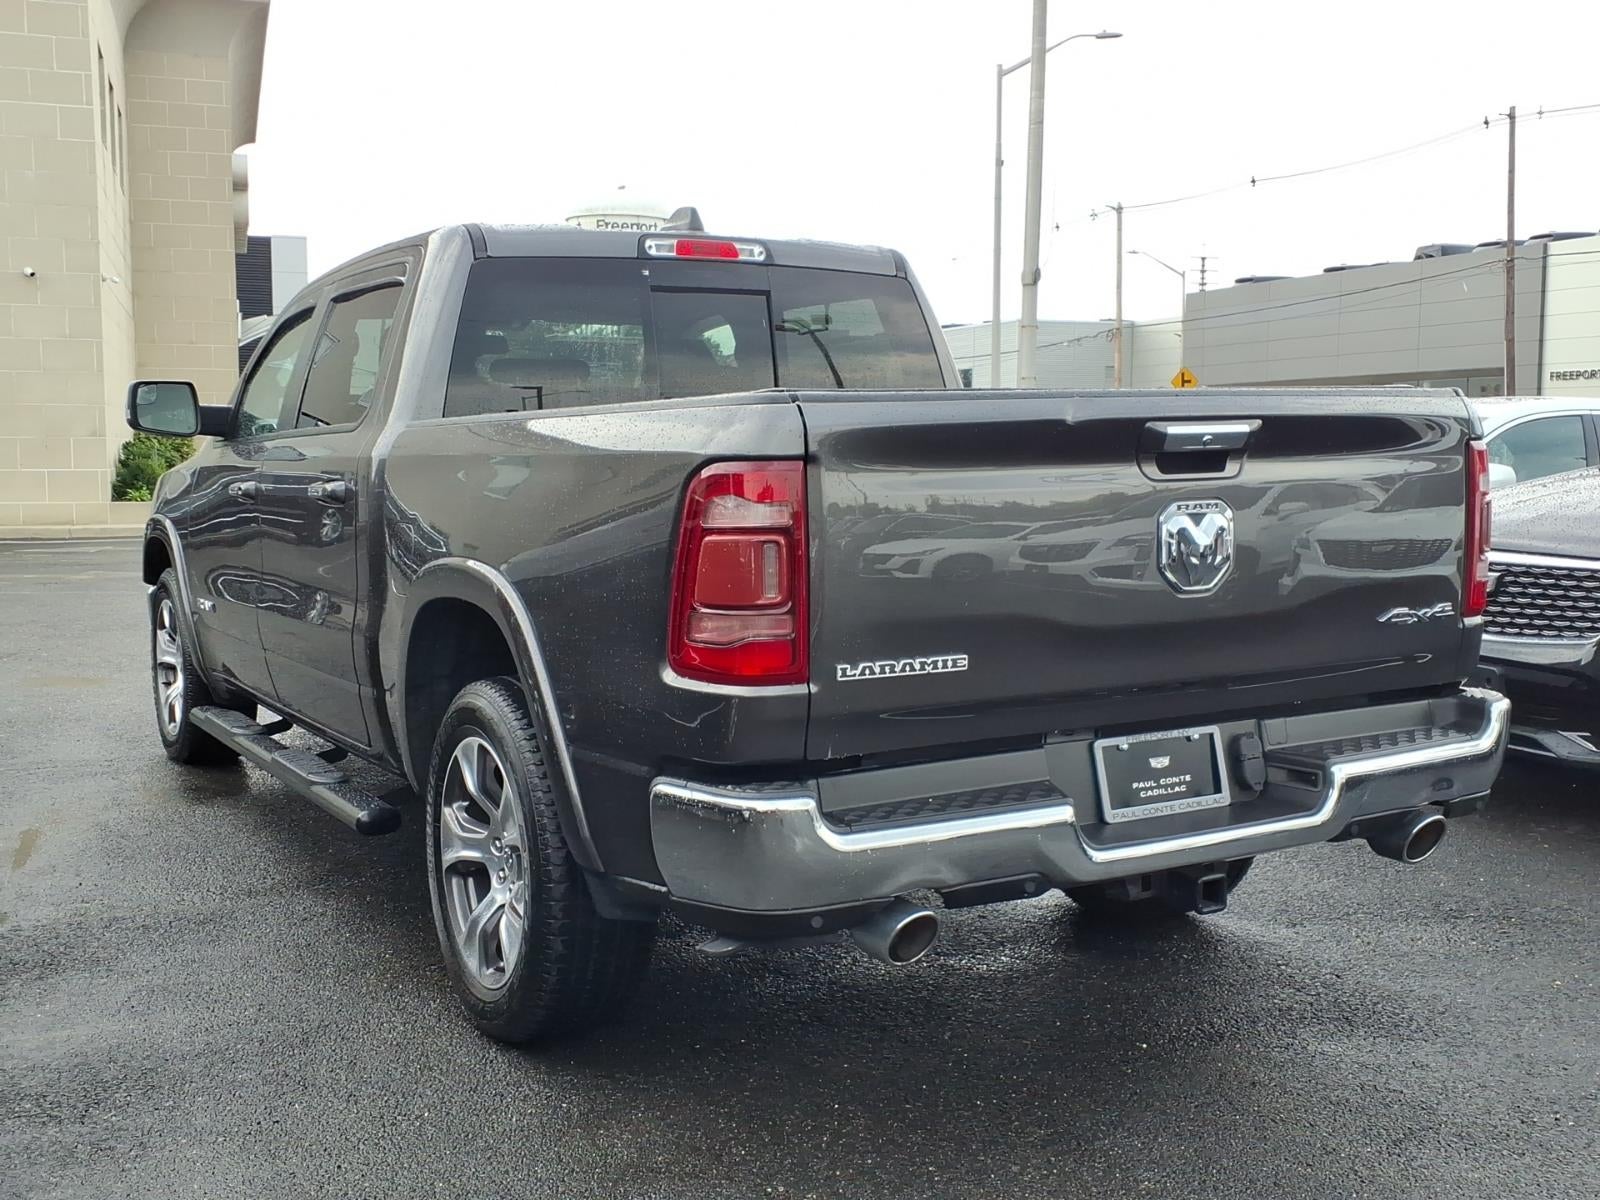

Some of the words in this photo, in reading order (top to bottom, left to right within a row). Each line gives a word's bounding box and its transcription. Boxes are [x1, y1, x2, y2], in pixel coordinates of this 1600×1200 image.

[1176, 502, 1219, 512] RAM
[836, 654, 969, 681] LARAMIE
[1132, 779, 1158, 790] PAUL
[1159, 774, 1192, 785] CONTE
[1140, 784, 1187, 798] CADILLAC
[1112, 809, 1141, 821] PAUL
[1142, 804, 1177, 817] CONTE
[1178, 797, 1225, 811] CADILLAC
